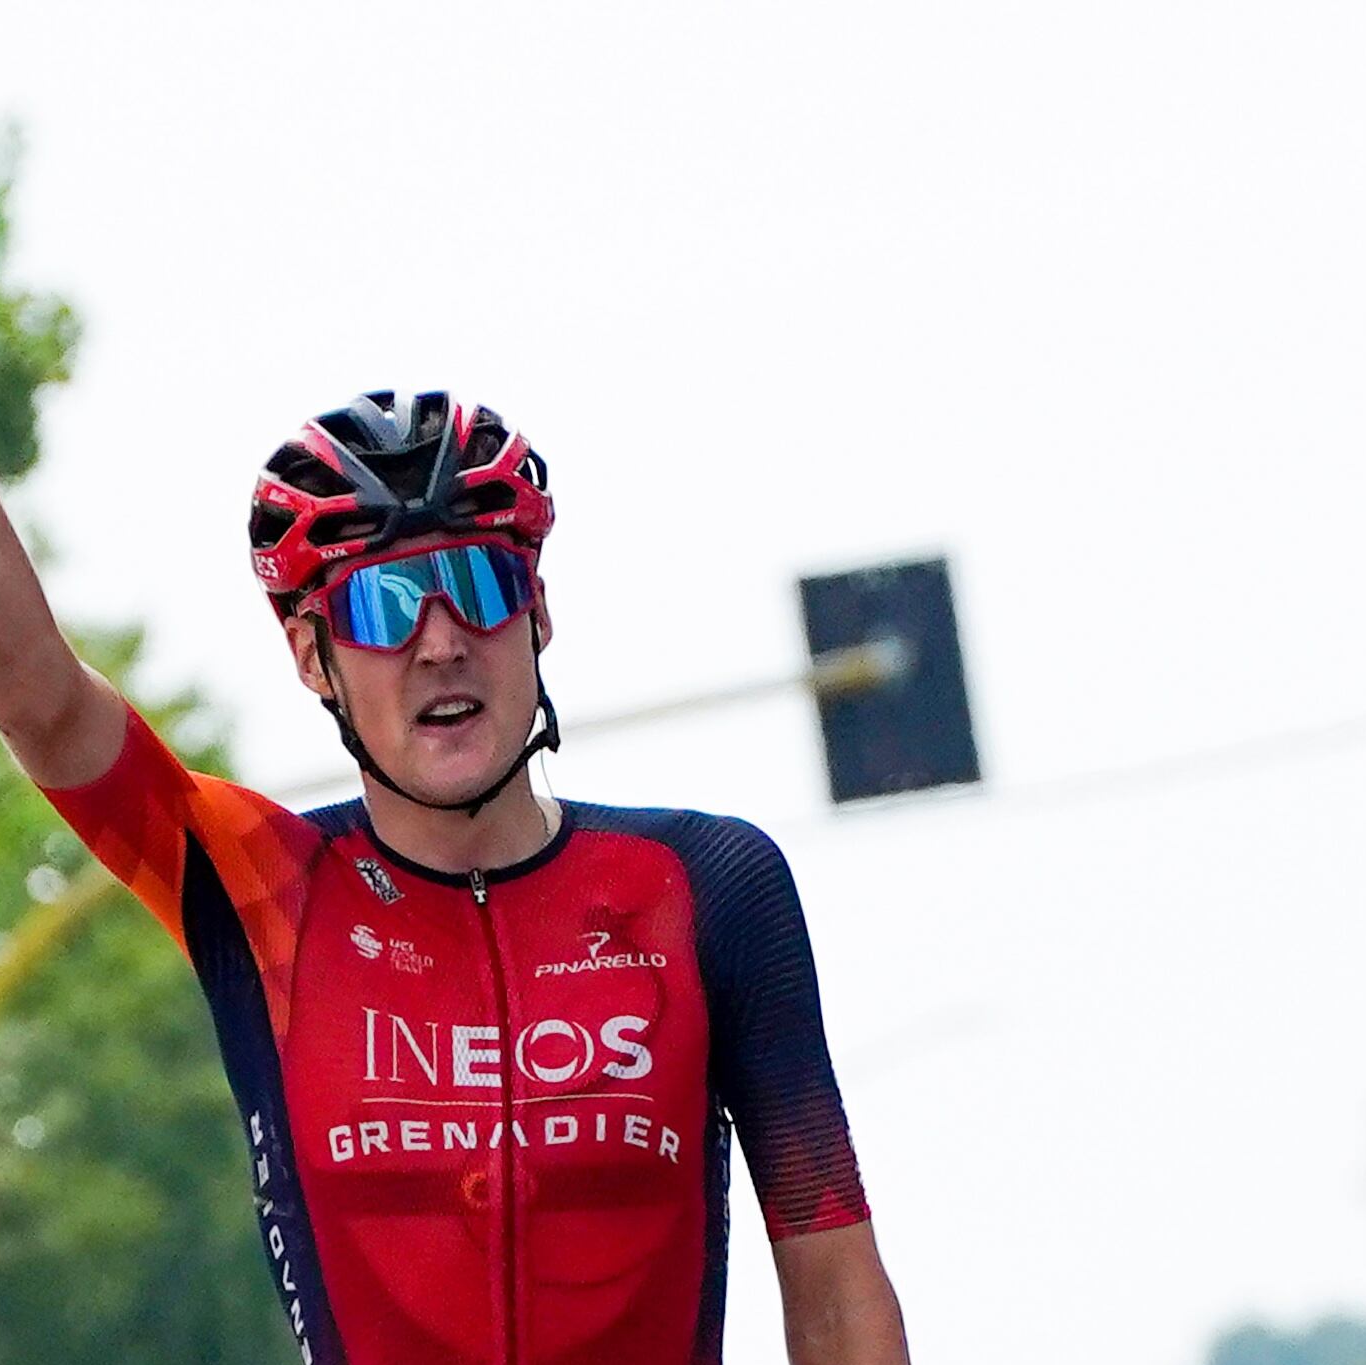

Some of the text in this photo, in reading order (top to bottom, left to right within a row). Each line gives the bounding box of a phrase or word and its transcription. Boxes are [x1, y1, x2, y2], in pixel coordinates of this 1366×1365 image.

[534, 952, 667, 978] PINARELLO
[362, 1005, 653, 1088] INEOS
[328, 1112, 681, 1165] GRENADIER
